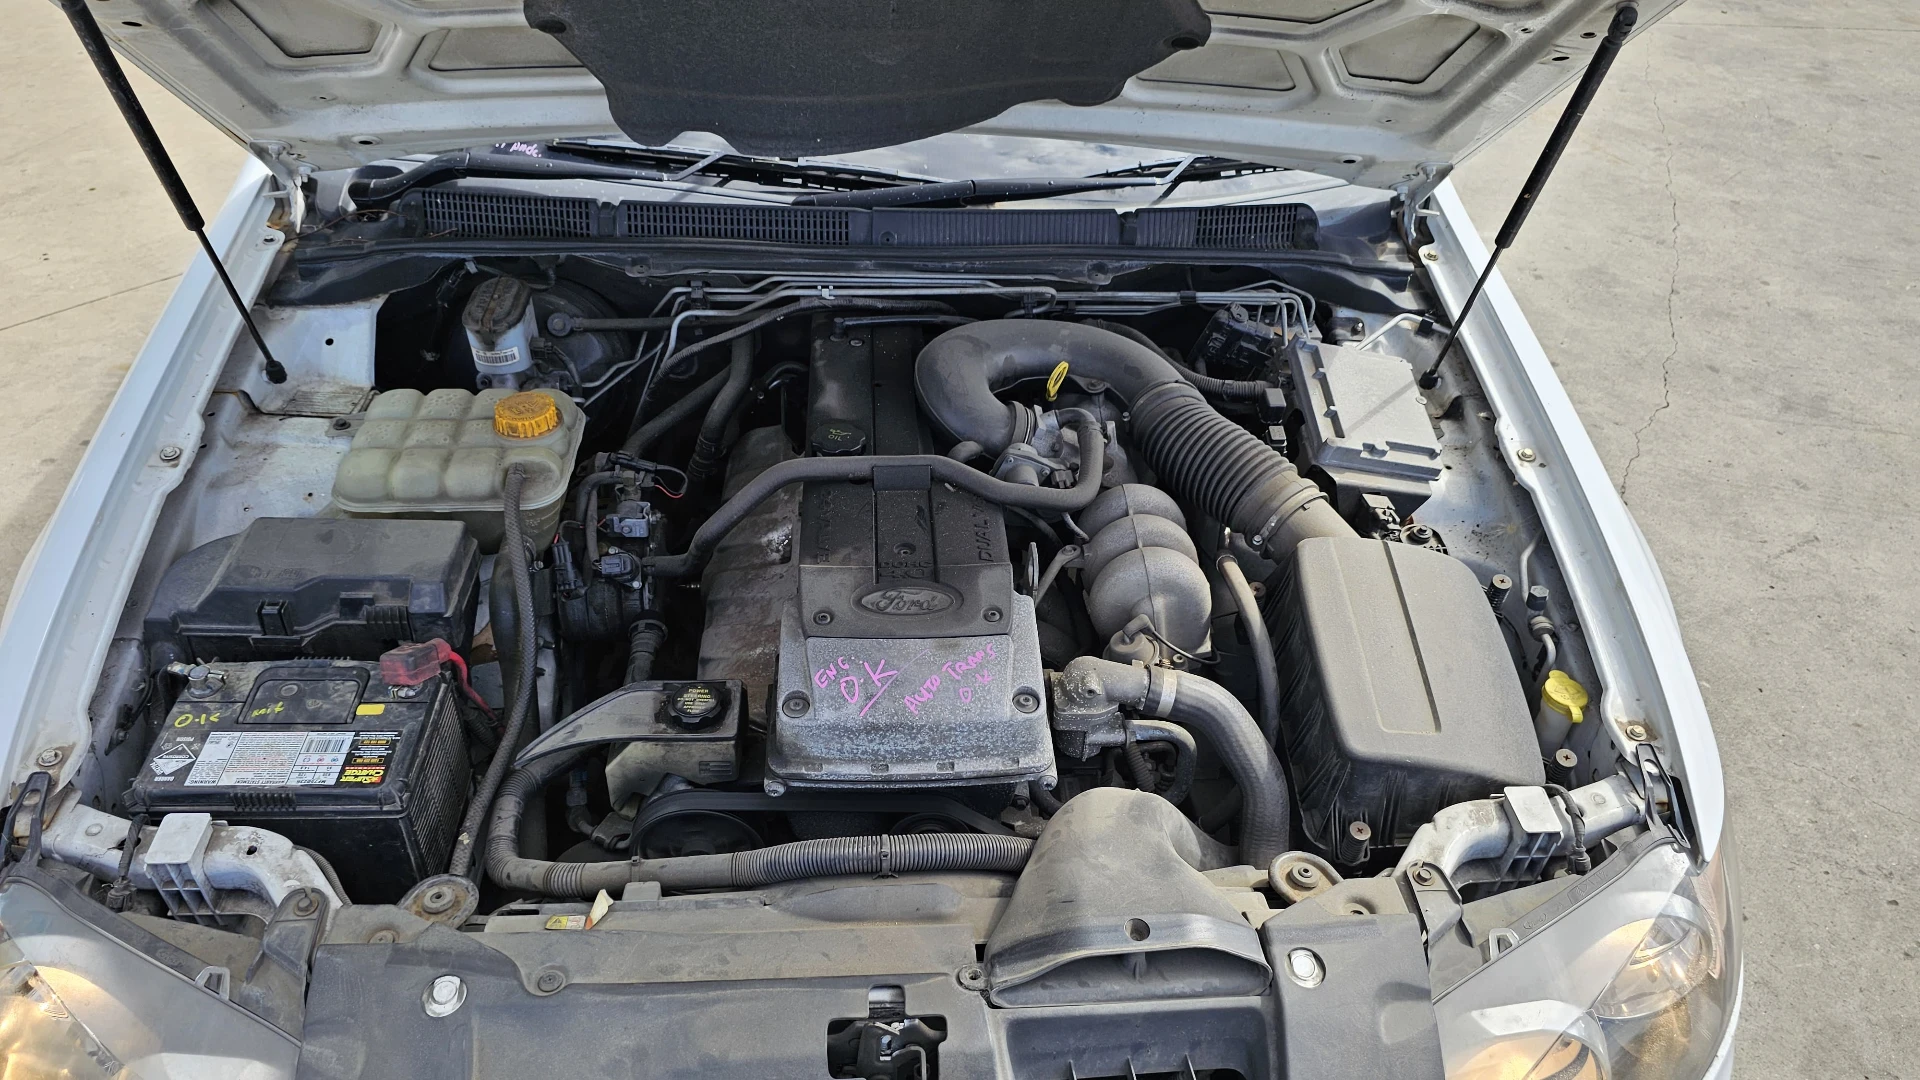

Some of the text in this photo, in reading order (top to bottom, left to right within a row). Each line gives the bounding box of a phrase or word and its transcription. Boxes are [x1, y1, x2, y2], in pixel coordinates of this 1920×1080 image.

[828, 434, 843, 442] OIL
[974, 519, 994, 563] DUAL
[875, 588, 938, 612] Ford
[903, 674, 942, 716] AUTO
[339, 775, 371, 783] SUPER
[343, 769, 384, 777] CHARGE
